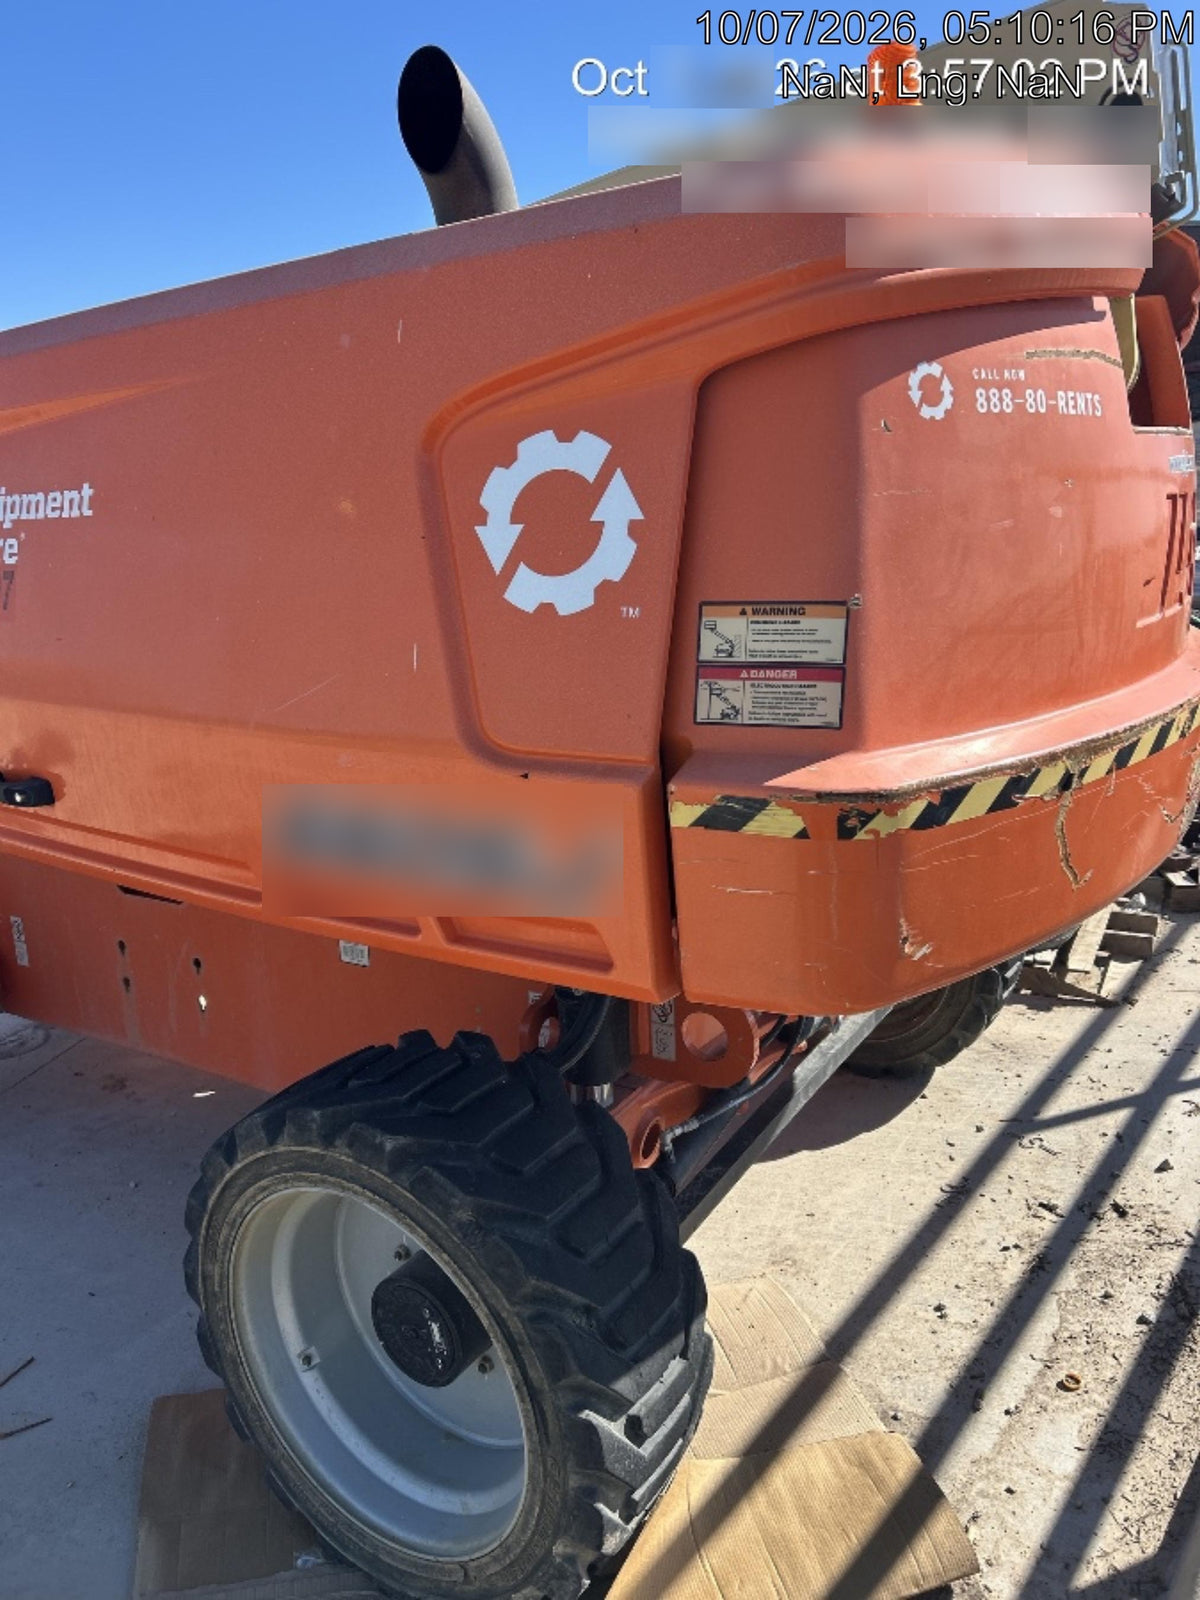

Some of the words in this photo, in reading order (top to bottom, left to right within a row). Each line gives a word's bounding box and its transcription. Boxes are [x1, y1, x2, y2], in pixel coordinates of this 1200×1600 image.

[972, 367, 1000, 380] CALL
[975, 386, 1103, 418] 888-80-RENTS
[619, 606, 641, 619] TM
[751, 606, 807, 617] WARNING
[749, 669, 798, 680] DANGER
